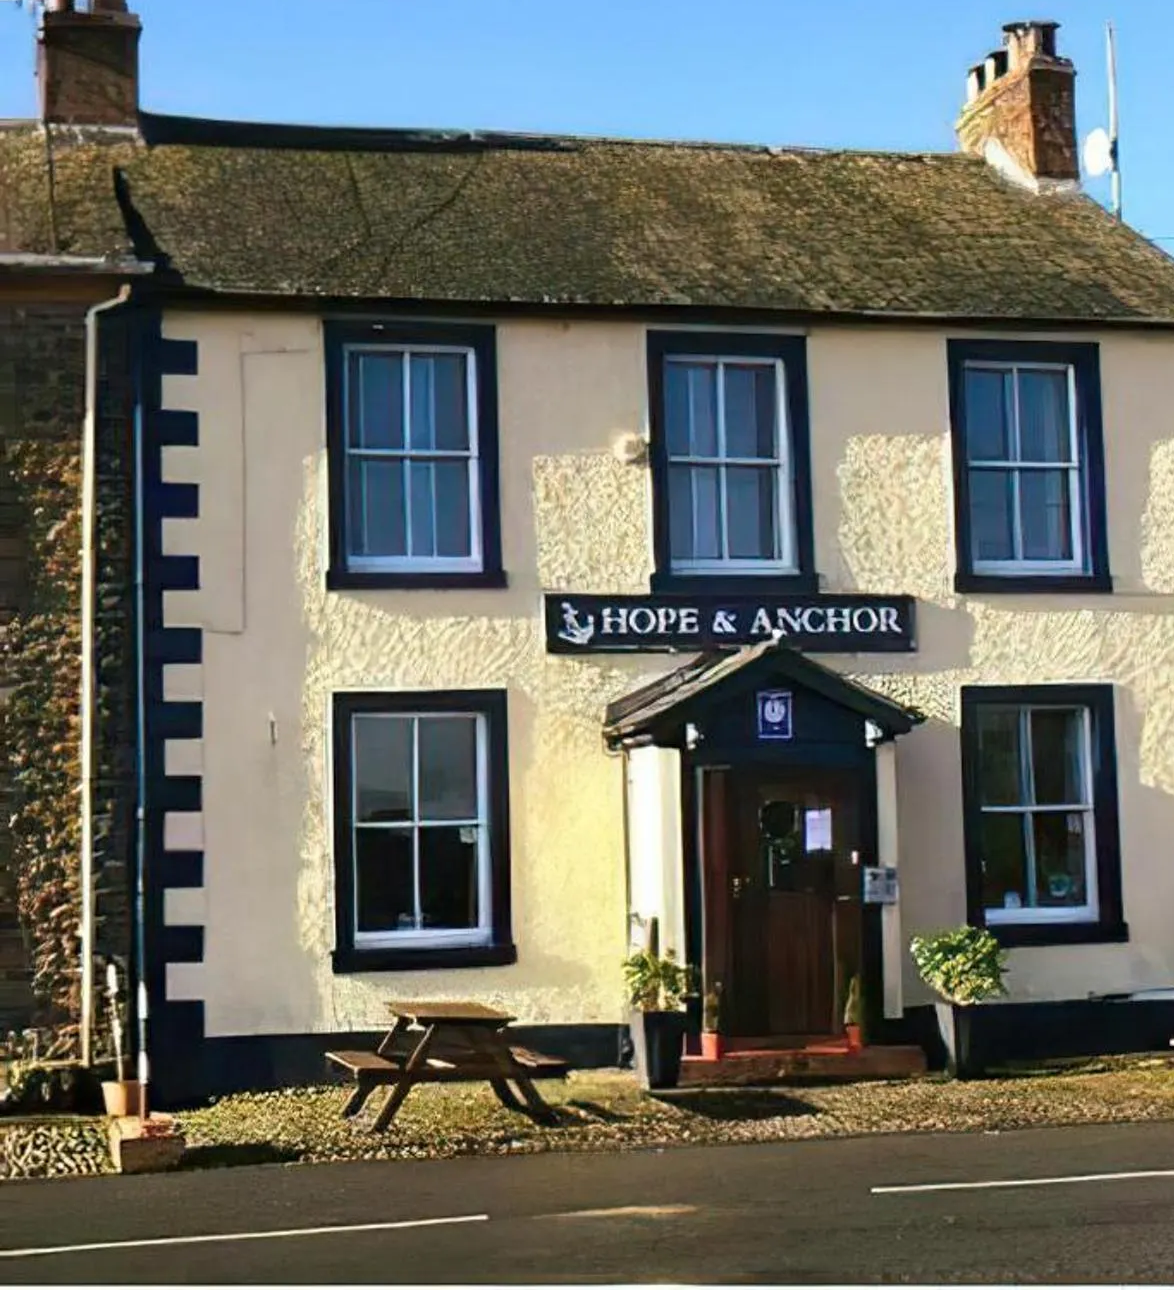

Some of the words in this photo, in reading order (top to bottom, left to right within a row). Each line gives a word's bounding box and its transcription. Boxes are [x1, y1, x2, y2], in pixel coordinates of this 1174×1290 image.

[601, 607, 700, 633] HOPE
[712, 610, 737, 634] &
[750, 606, 902, 633] ANCHOR
